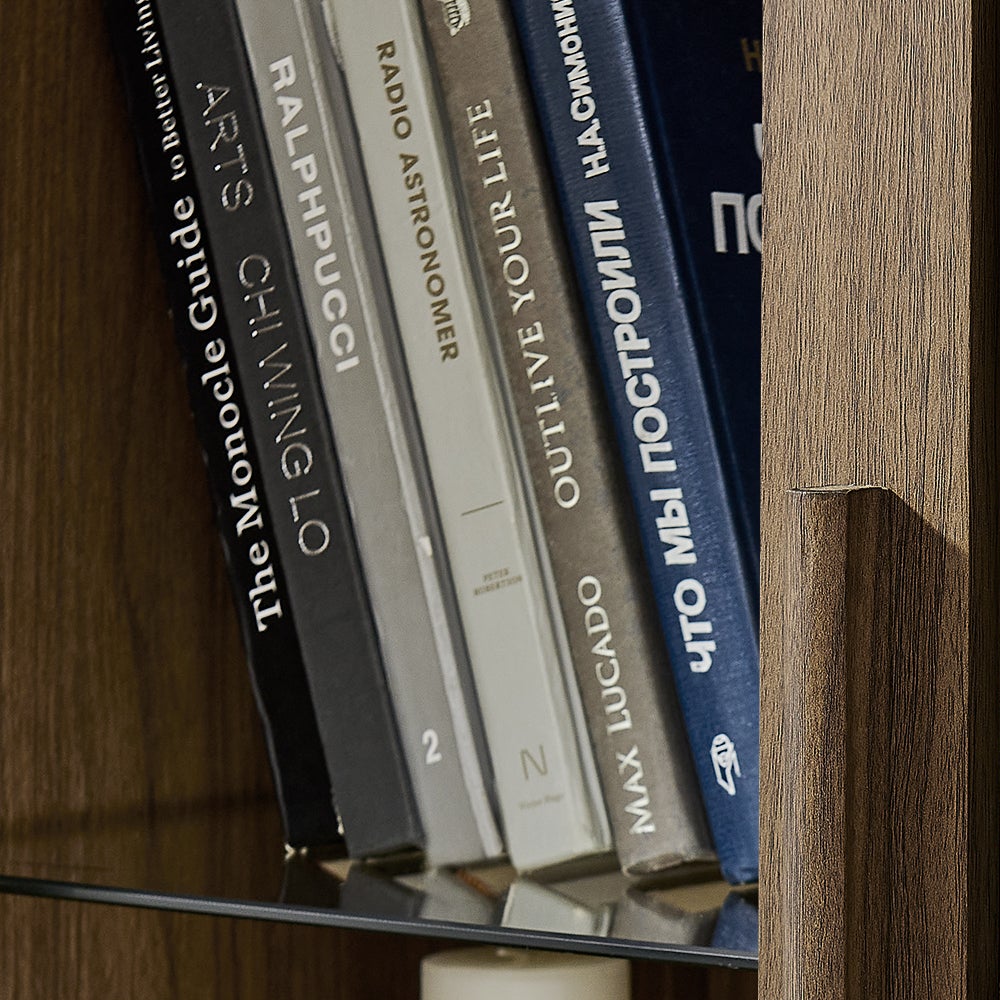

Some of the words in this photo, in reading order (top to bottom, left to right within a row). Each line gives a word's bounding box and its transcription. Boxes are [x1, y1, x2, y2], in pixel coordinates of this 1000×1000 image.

[152, 73, 181, 153] Better
[170, 152, 188, 182] to
[196, 82, 254, 211] ARTS
[466, 99, 508, 188] LIFE
[376, 39, 412, 141] RADIO
[399, 151, 460, 363] ASTRONOMER
[489, 190, 536, 315] YOUR
[170, 194, 218, 331] Guide
[584, 200, 678, 473] ПОСТРОИЛИ
[201, 337, 264, 536] Monocle
[517, 321, 580, 509] OUTLIVE
[650, 487, 698, 566] МЫ
[248, 539, 284, 632] The
[673, 578, 717, 673] ЧТО
[577, 575, 633, 736] LUCADO
[421, 728, 443, 765] 2
[615, 744, 657, 835] MAX
